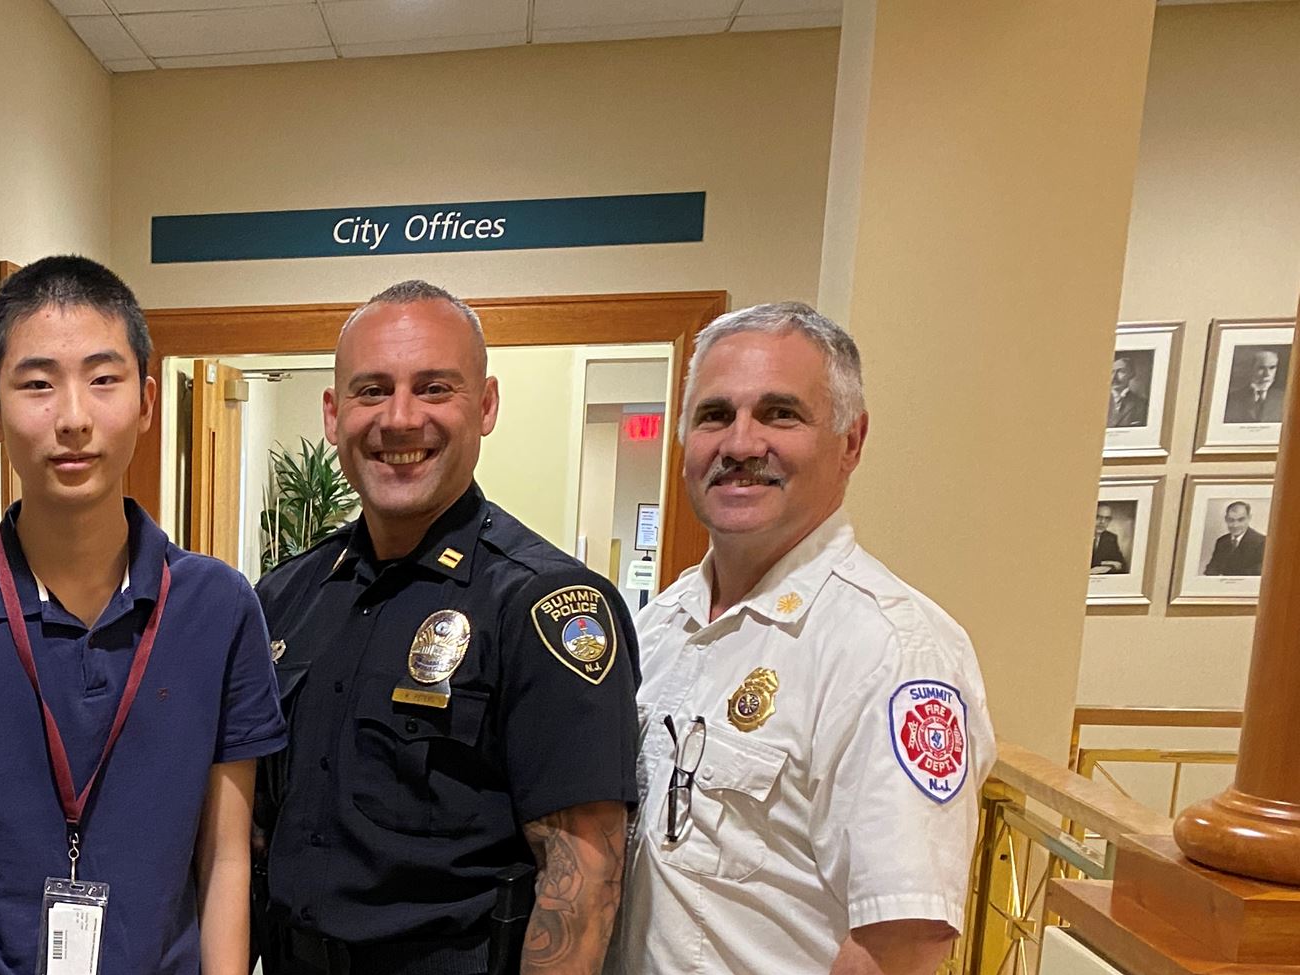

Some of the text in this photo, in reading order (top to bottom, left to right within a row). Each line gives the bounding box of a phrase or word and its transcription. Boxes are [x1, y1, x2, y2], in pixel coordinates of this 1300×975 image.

[333, 212, 506, 250] City Offices
[540, 591, 600, 614] SUMMIT
[550, 601, 598, 622] POLICE
[909, 687, 953, 703] SUMMIT
[924, 704, 946, 716] FIRE
